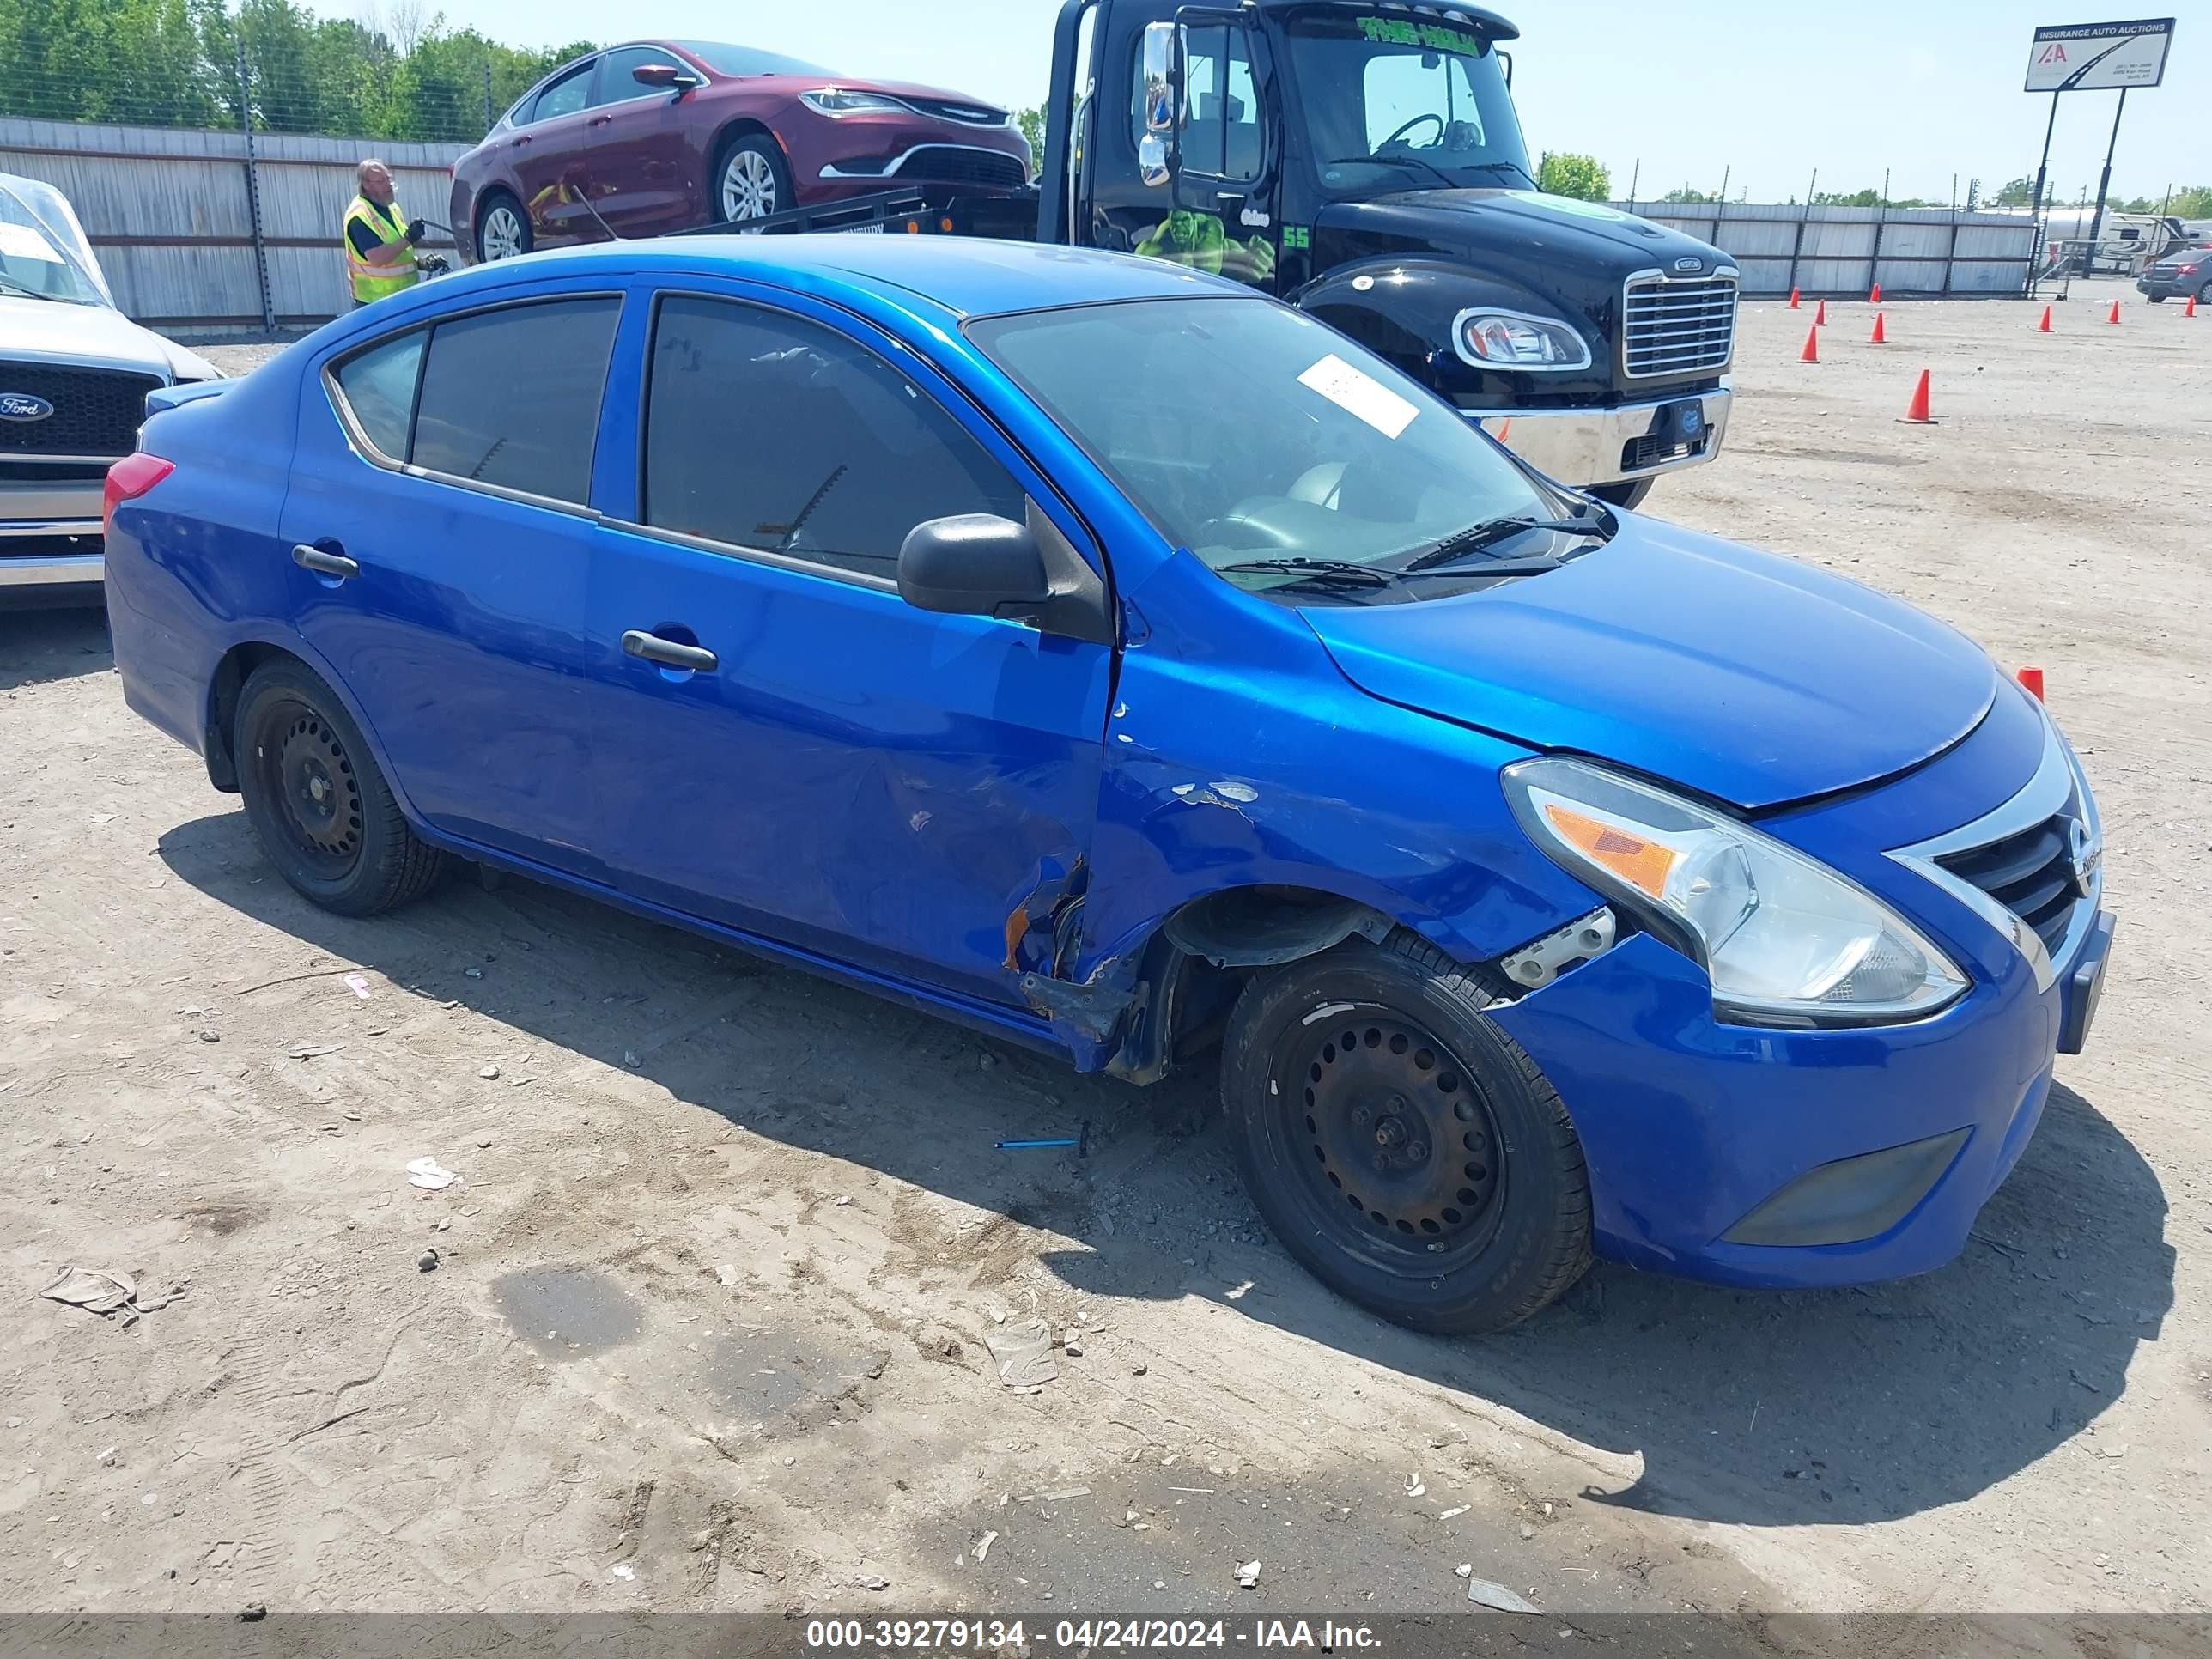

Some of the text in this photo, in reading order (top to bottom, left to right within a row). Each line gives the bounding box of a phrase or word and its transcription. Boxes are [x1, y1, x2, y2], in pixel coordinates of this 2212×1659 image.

[2039, 23, 2166, 40] INSURANCE AUTO AUCTIONS
[1283, 226, 1310, 248] 55
[1, 398, 40, 416] Ford
